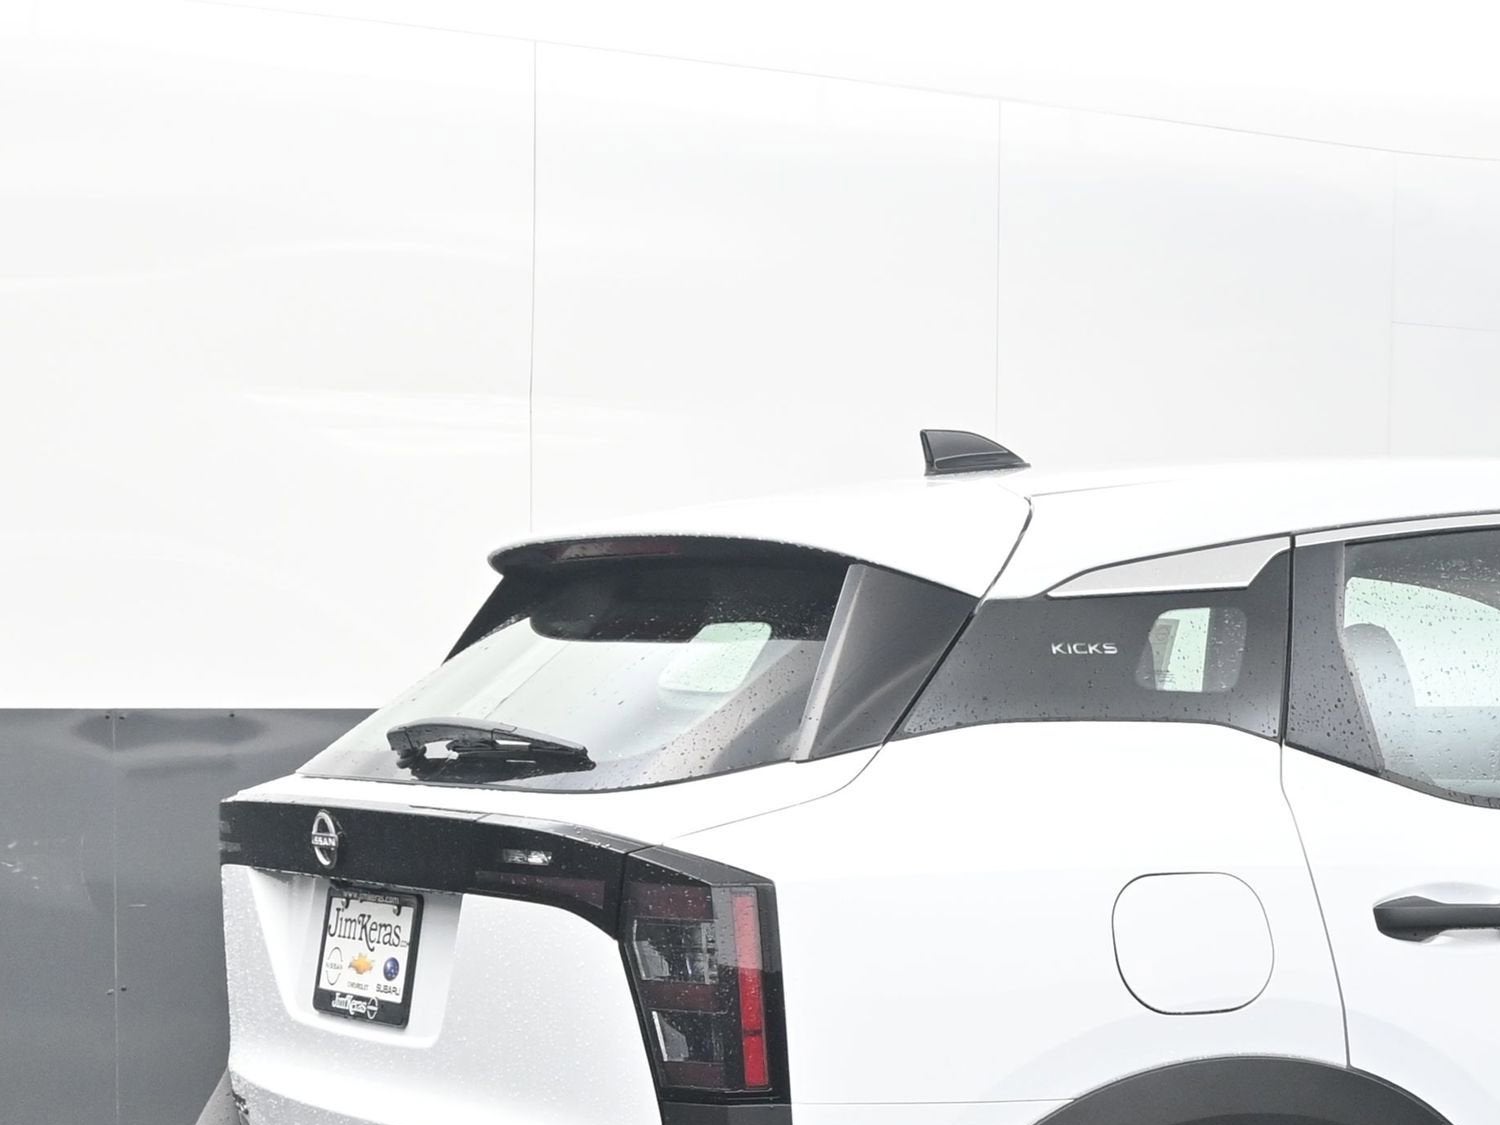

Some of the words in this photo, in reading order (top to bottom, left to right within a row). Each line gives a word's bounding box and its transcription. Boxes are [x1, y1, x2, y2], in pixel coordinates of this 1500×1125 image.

[1051, 642, 1118, 655] KICKS
[312, 835, 336, 847] SSAN
[376, 983, 401, 996] SUBARU
